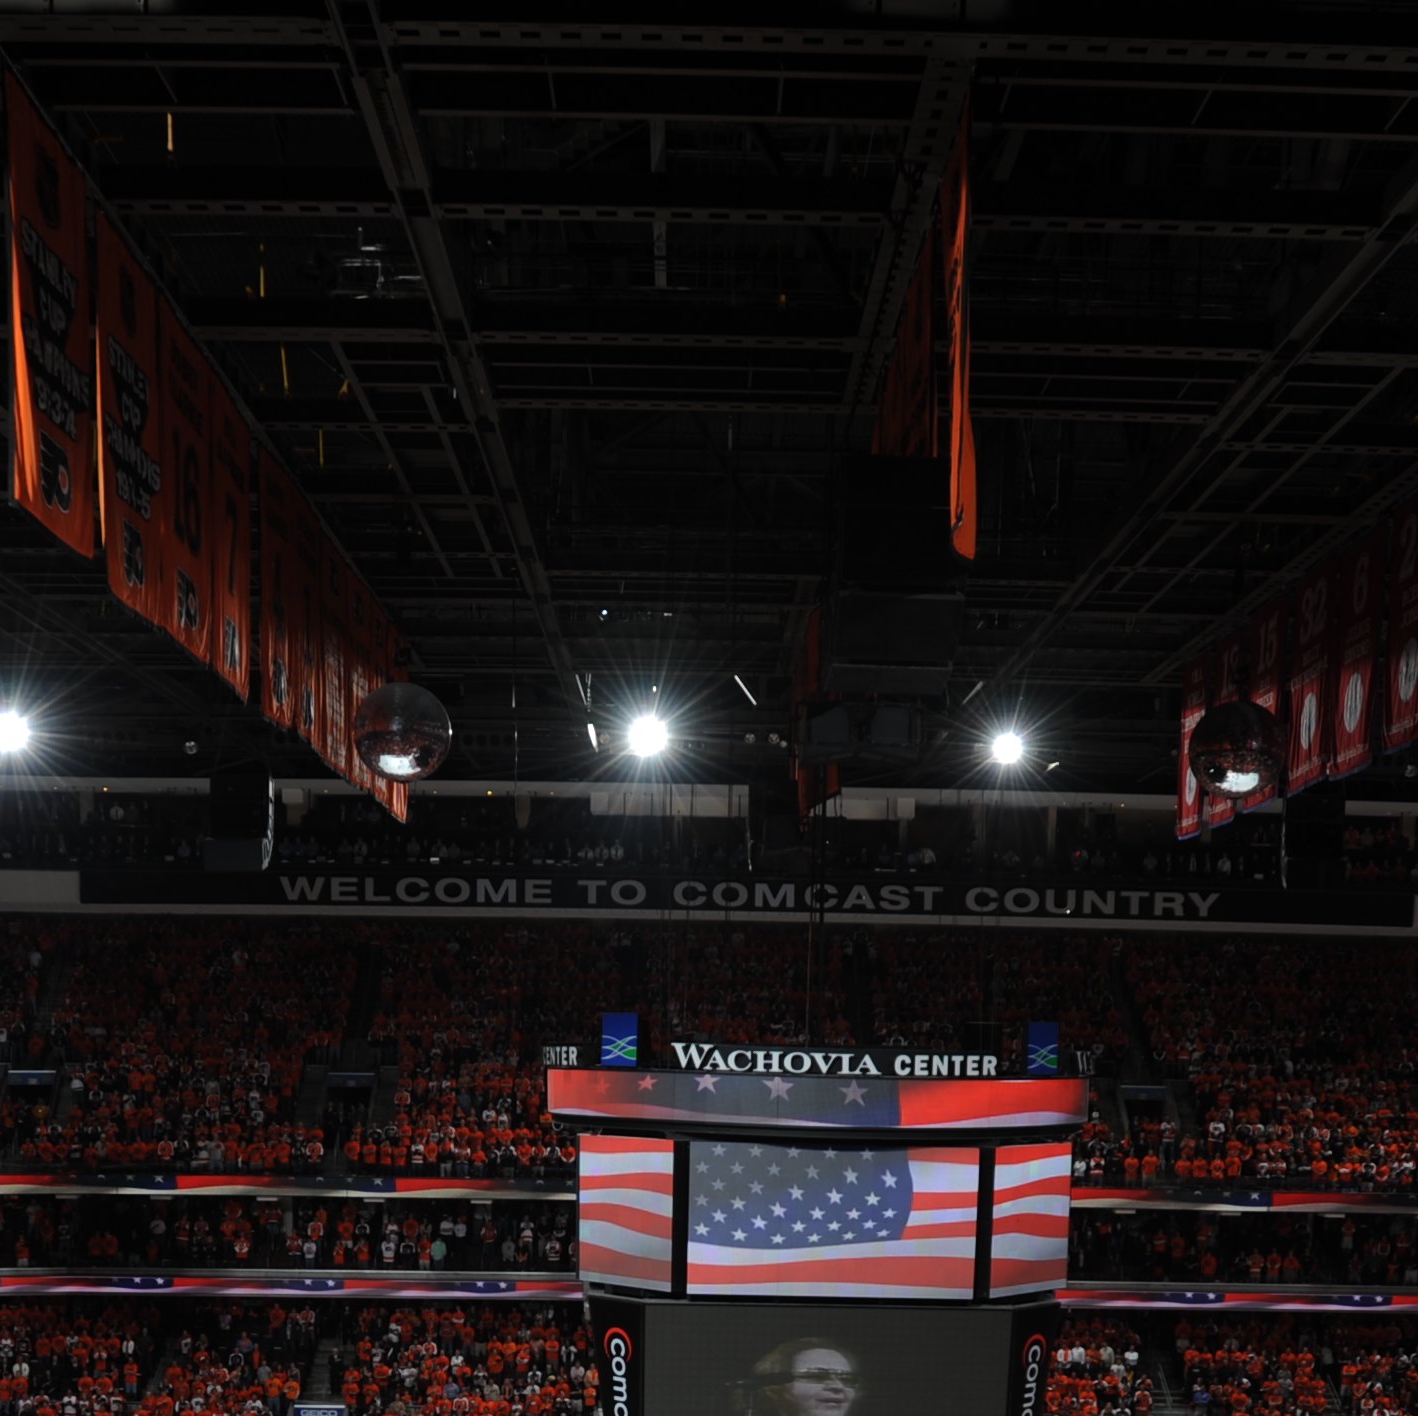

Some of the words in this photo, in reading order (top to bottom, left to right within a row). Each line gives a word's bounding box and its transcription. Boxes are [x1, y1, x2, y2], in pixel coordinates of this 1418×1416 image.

[280, 875, 553, 904] WELCOME
[578, 879, 647, 905] TO
[672, 879, 944, 912] COMCAST
[964, 886, 1222, 918] COUNTRY
[671, 1042, 881, 1076] WACHOVIA
[894, 1054, 998, 1077] CENTER
